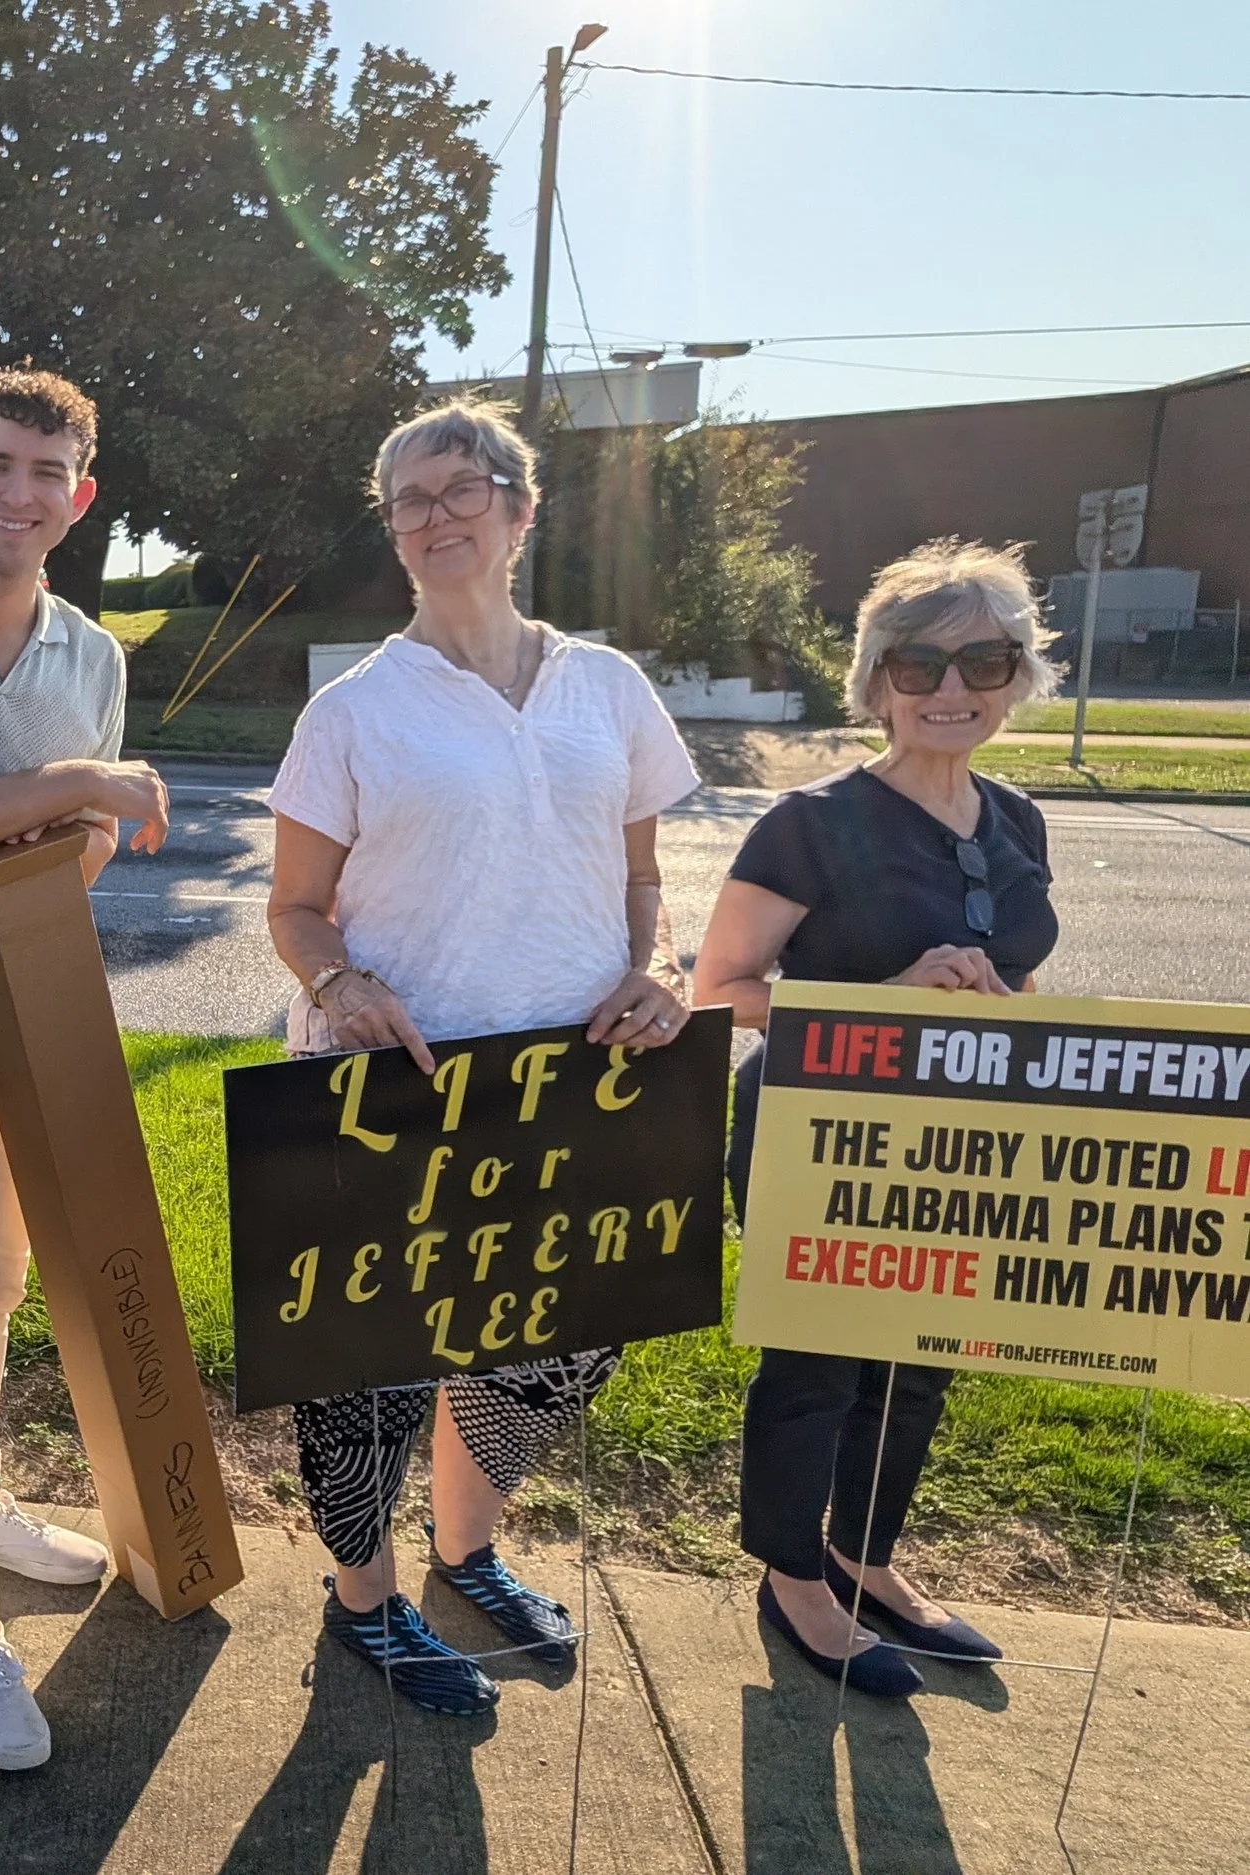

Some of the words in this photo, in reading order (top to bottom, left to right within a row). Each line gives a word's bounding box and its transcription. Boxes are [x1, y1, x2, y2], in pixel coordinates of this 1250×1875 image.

[329, 1042, 645, 1152] LIFE
[802, 1022, 903, 1079] LIFE
[916, 1028, 1012, 1086] FOR
[1025, 1035, 1250, 1101] JEFFERY
[407, 1146, 571, 1224] for
[810, 1118, 891, 1168] THE
[904, 1125, 1024, 1178] JURY
[1041, 1134, 1191, 1191] VOTED
[823, 1180, 1049, 1243] ALABAMA
[1067, 1198, 1224, 1257] PLANS
[280, 1197, 694, 1324] JEFFERY
[785, 1236, 980, 1298] EXECUTE
[993, 1254, 1089, 1308] HIM
[1103, 1265, 1250, 1323] ANYW
[101, 1247, 169, 1419] (INDIVISIBLE)
[424, 1287, 559, 1366] LEE
[916, 1334, 1157, 1375] WWW.LIFEFORJEFFERYLEE.COM
[163, 1441, 214, 1596] BANNERS
